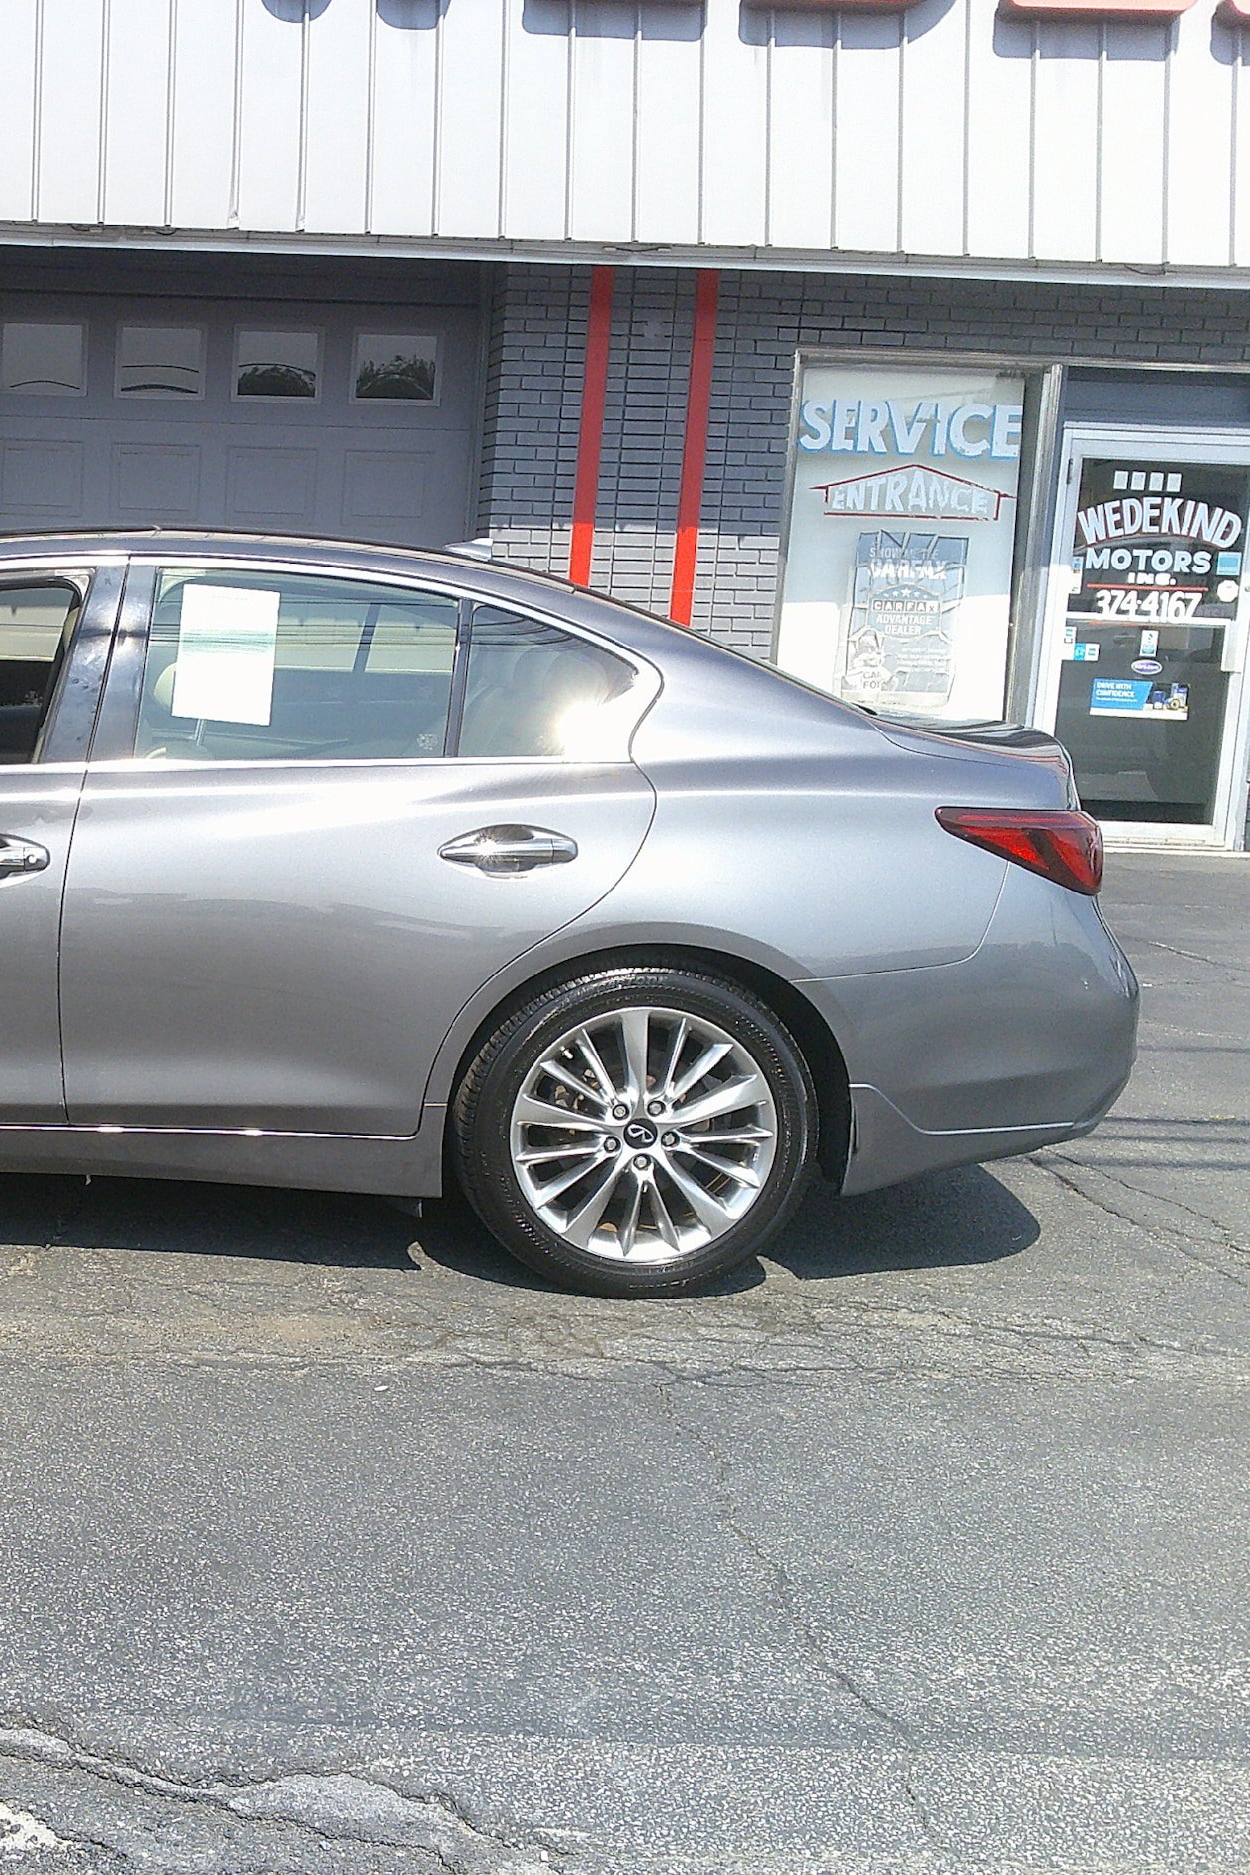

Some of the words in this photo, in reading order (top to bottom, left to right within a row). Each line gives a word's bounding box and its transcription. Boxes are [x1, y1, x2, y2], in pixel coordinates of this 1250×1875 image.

[800, 400, 1022, 460] SERVICE
[832, 471, 988, 514] ENTRANCE
[1077, 496, 1243, 548] WEDEKIND
[870, 559, 947, 580] CARFAX
[1085, 548, 1212, 574] MOTORS
[1127, 572, 1177, 586] INC.
[873, 600, 935, 612] CARFAX
[876, 613, 934, 625] ADVANTAGE
[884, 624, 922, 636] DEALER
